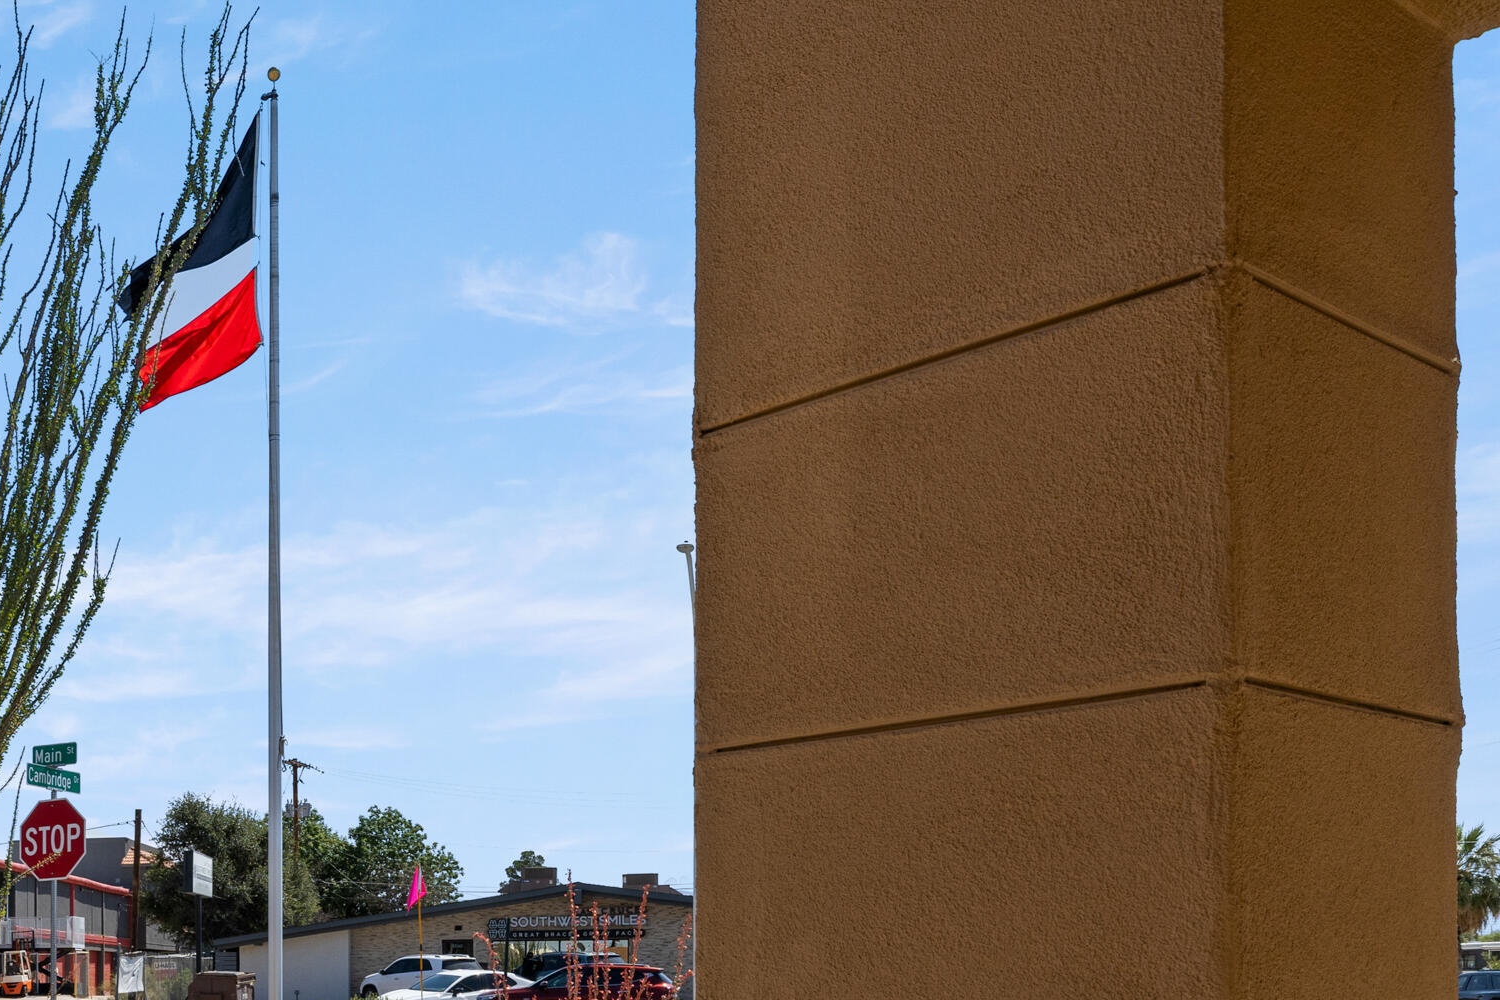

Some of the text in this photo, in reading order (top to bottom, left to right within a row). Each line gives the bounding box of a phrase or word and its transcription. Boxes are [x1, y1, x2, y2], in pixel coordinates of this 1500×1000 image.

[34, 746, 74, 764] Main St
[28, 767, 80, 791] Cambridge Dr
[24, 823, 80, 856] STOP
[510, 915, 595, 928] SOUTHWEST
